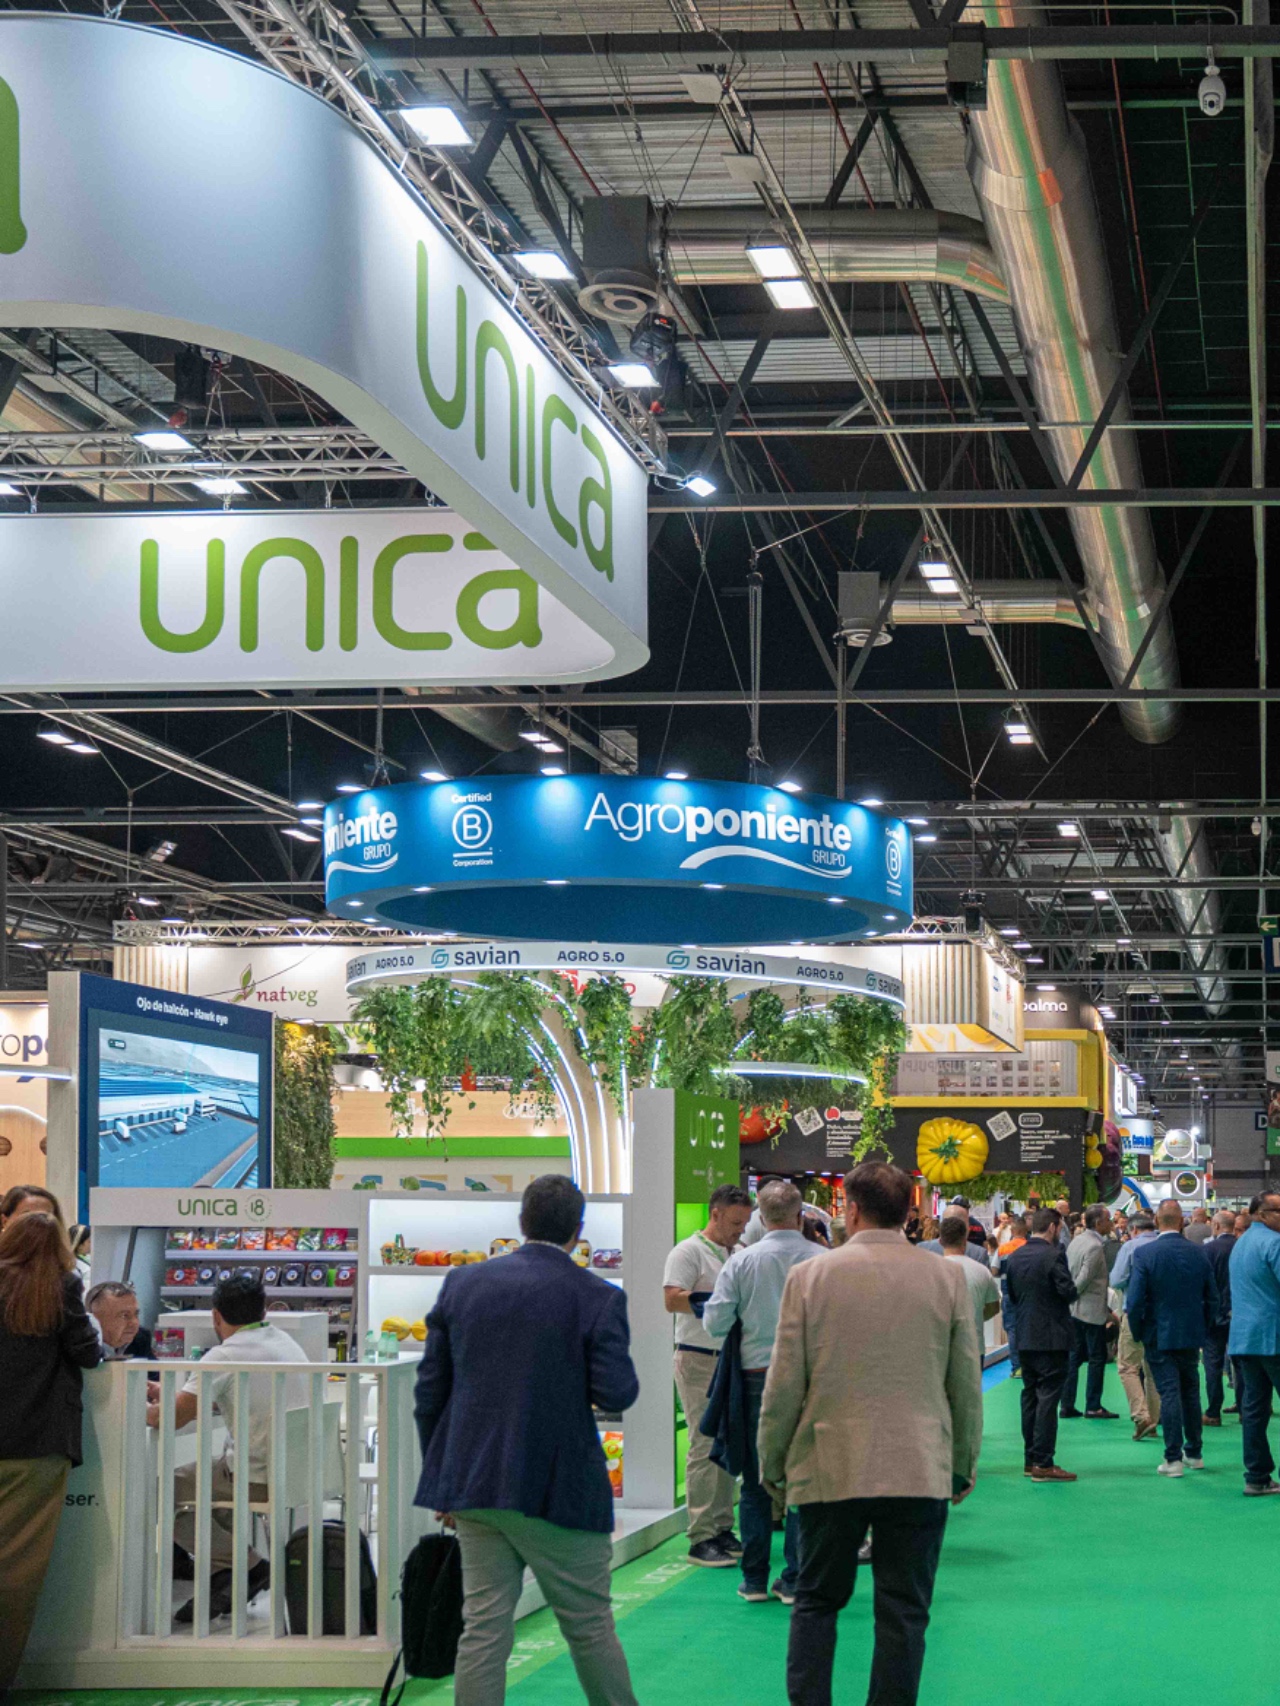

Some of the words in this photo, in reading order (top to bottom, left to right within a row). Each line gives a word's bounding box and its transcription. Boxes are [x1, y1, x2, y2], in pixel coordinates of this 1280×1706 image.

[462, 813, 482, 841] B
[584, 792, 852, 850] Agroponiente
[363, 843, 391, 861] GRUPO
[812, 849, 845, 867] GRUPO
[375, 958, 398, 970] AGRO
[400, 955, 414, 967] 5.0
[454, 946, 520, 966] savian
[557, 951, 599, 962] AGRO
[602, 951, 625, 963] 5.0
[696, 954, 766, 975] savian
[796, 965, 828, 979] AGRO
[829, 970, 844, 982] 5.0
[256, 986, 318, 1006] natveg
[136, 996, 151, 1011] Ojo
[153, 1001, 163, 1011] de
[163, 1002, 189, 1017] halcón
[194, 1008, 215, 1021] Hawk
[216, 1014, 229, 1026] eye
